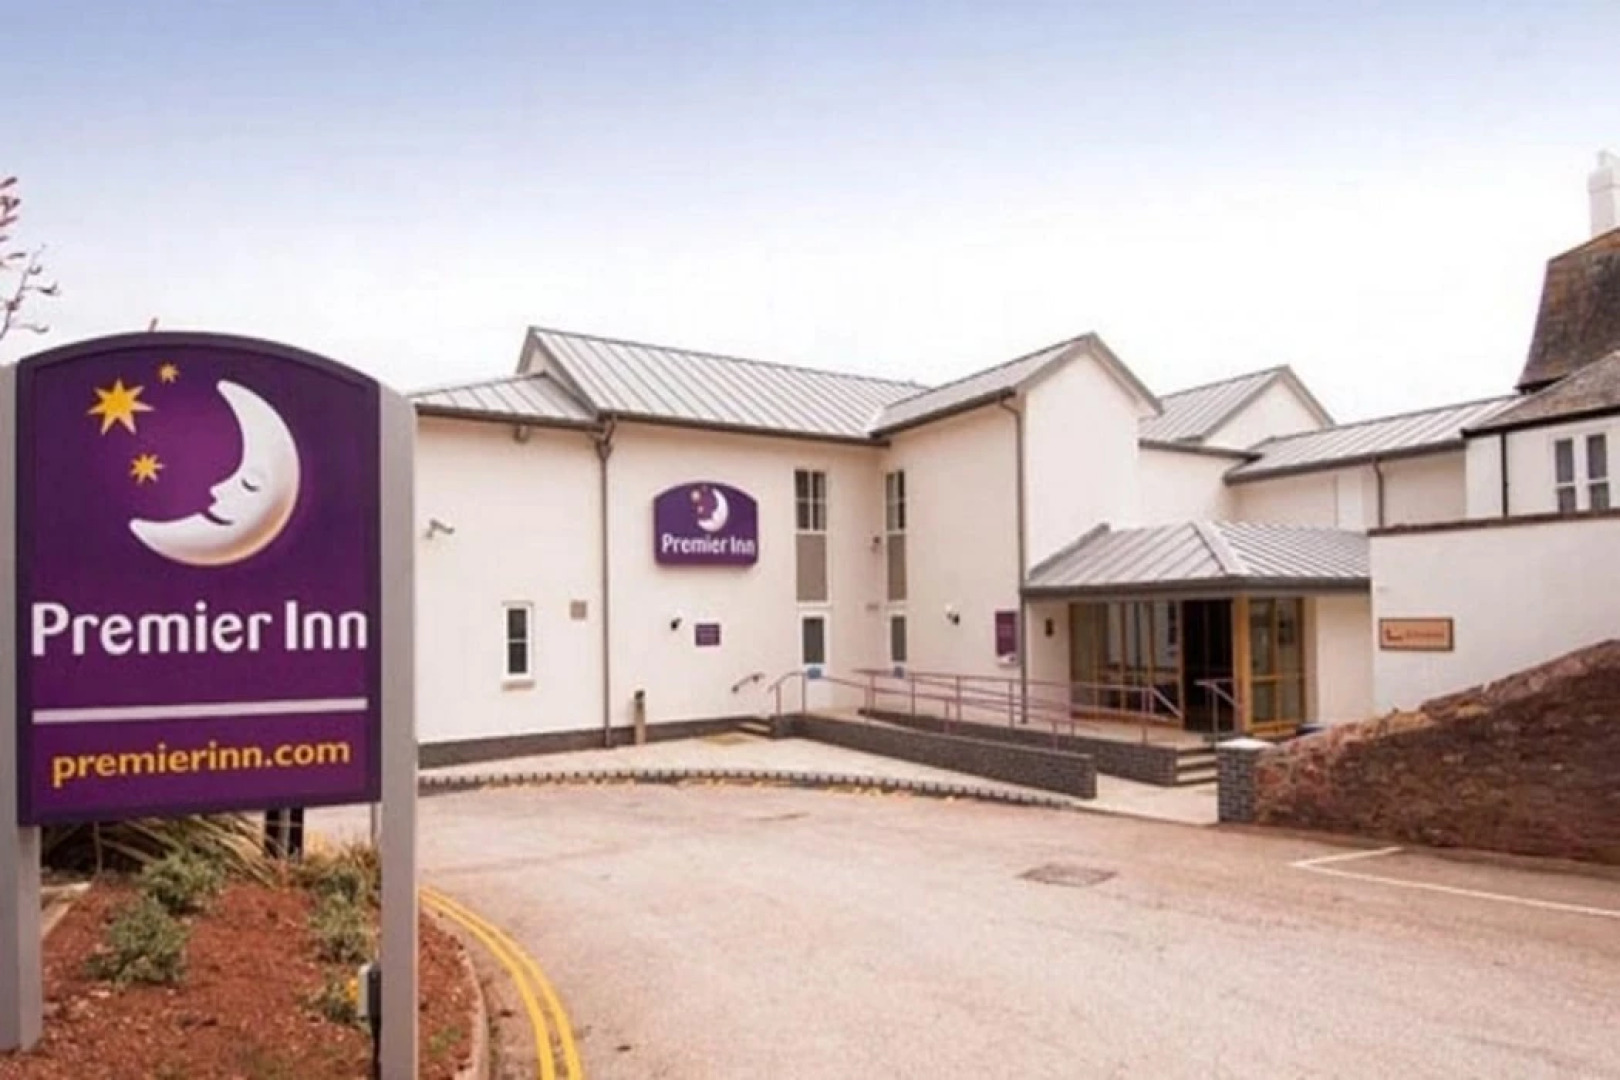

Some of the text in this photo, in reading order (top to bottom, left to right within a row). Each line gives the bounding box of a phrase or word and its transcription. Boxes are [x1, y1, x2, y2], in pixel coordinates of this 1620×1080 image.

[662, 533, 755, 555] Premier Inn
[31, 600, 367, 657] Premier Inn
[52, 739, 350, 788] premierinn.com
